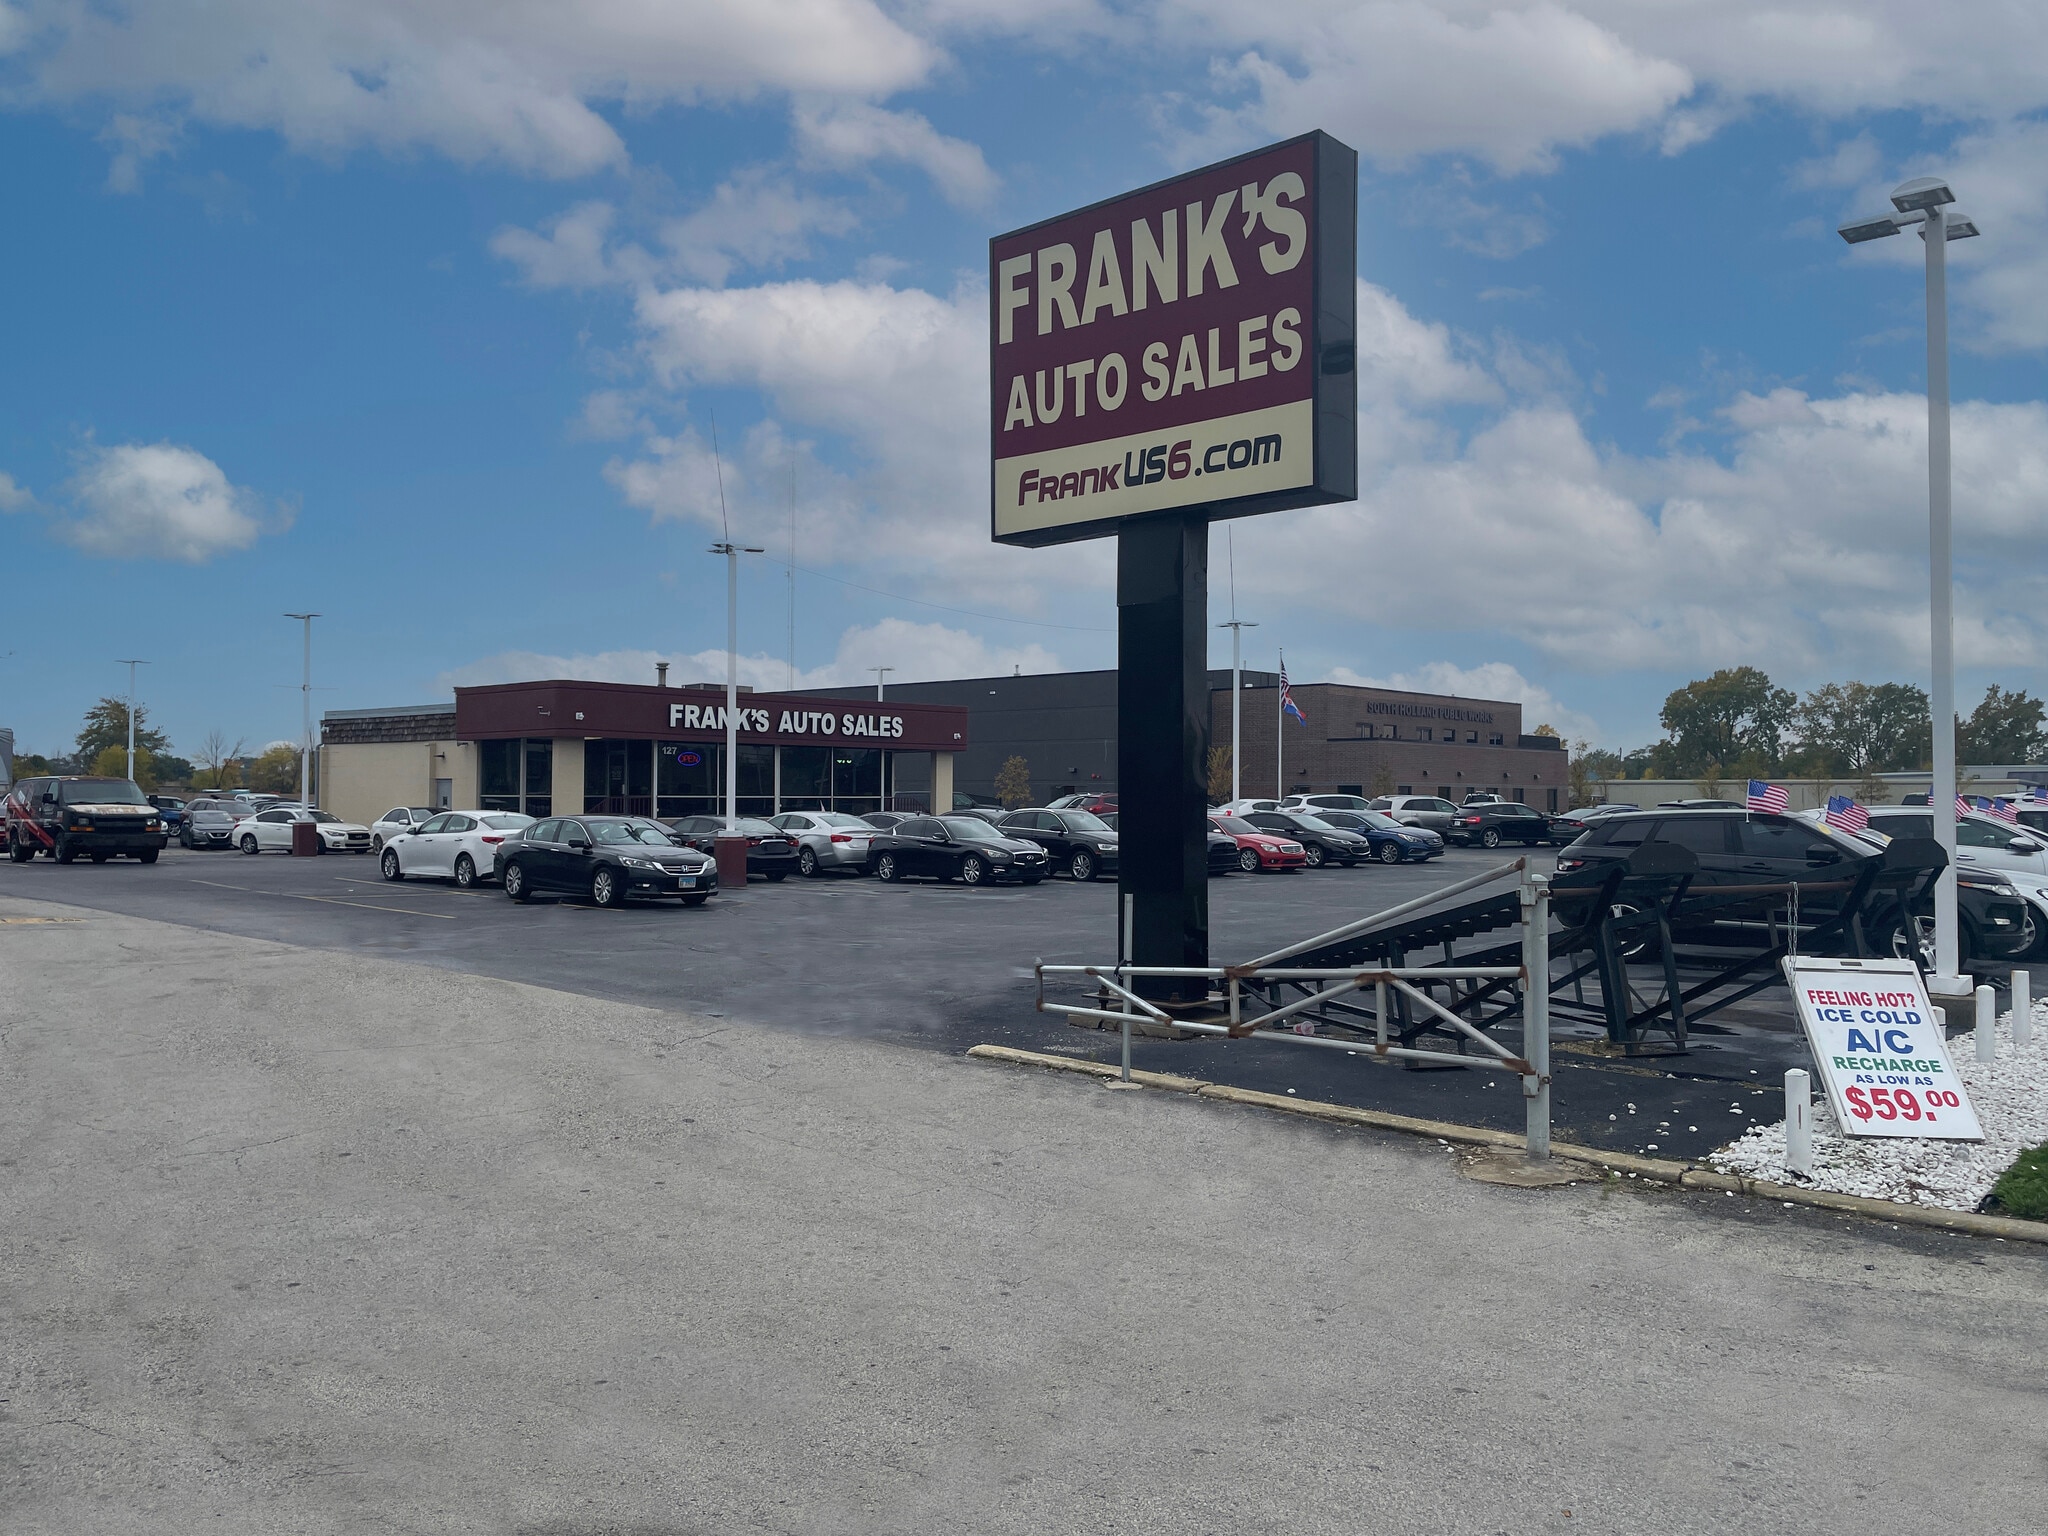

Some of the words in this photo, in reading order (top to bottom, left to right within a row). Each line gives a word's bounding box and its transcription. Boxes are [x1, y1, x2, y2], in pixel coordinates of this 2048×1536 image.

[999, 171, 1307, 345] FRANK'S
[1004, 352, 1128, 432] AUTO
[1141, 307, 1303, 402] SALES
[669, 703, 770, 732] FRANK'S
[778, 711, 836, 735] AUTO
[842, 713, 903, 738] SALES
[1367, 701, 1397, 714] SOUTH
[1399, 704, 1437, 719] HOLLAND
[1438, 708, 1466, 721] PUBLIC
[1466, 710, 1494, 724] WORKS
[661, 746, 678, 755] 127
[1807, 989, 1873, 1007] FEELING
[1874, 991, 1916, 1008] HOT?
[1815, 1008, 1854, 1023] ICE
[1861, 1010, 1921, 1025] COLD
[1847, 1028, 1914, 1054] A/C
[1832, 1056, 1943, 1073] RECHARGE
[1855, 1074, 1875, 1084] AS
[1878, 1075, 1910, 1085] LOW
[1914, 1076, 1934, 1086] AS
[1845, 1085, 1960, 1123] $59.00
